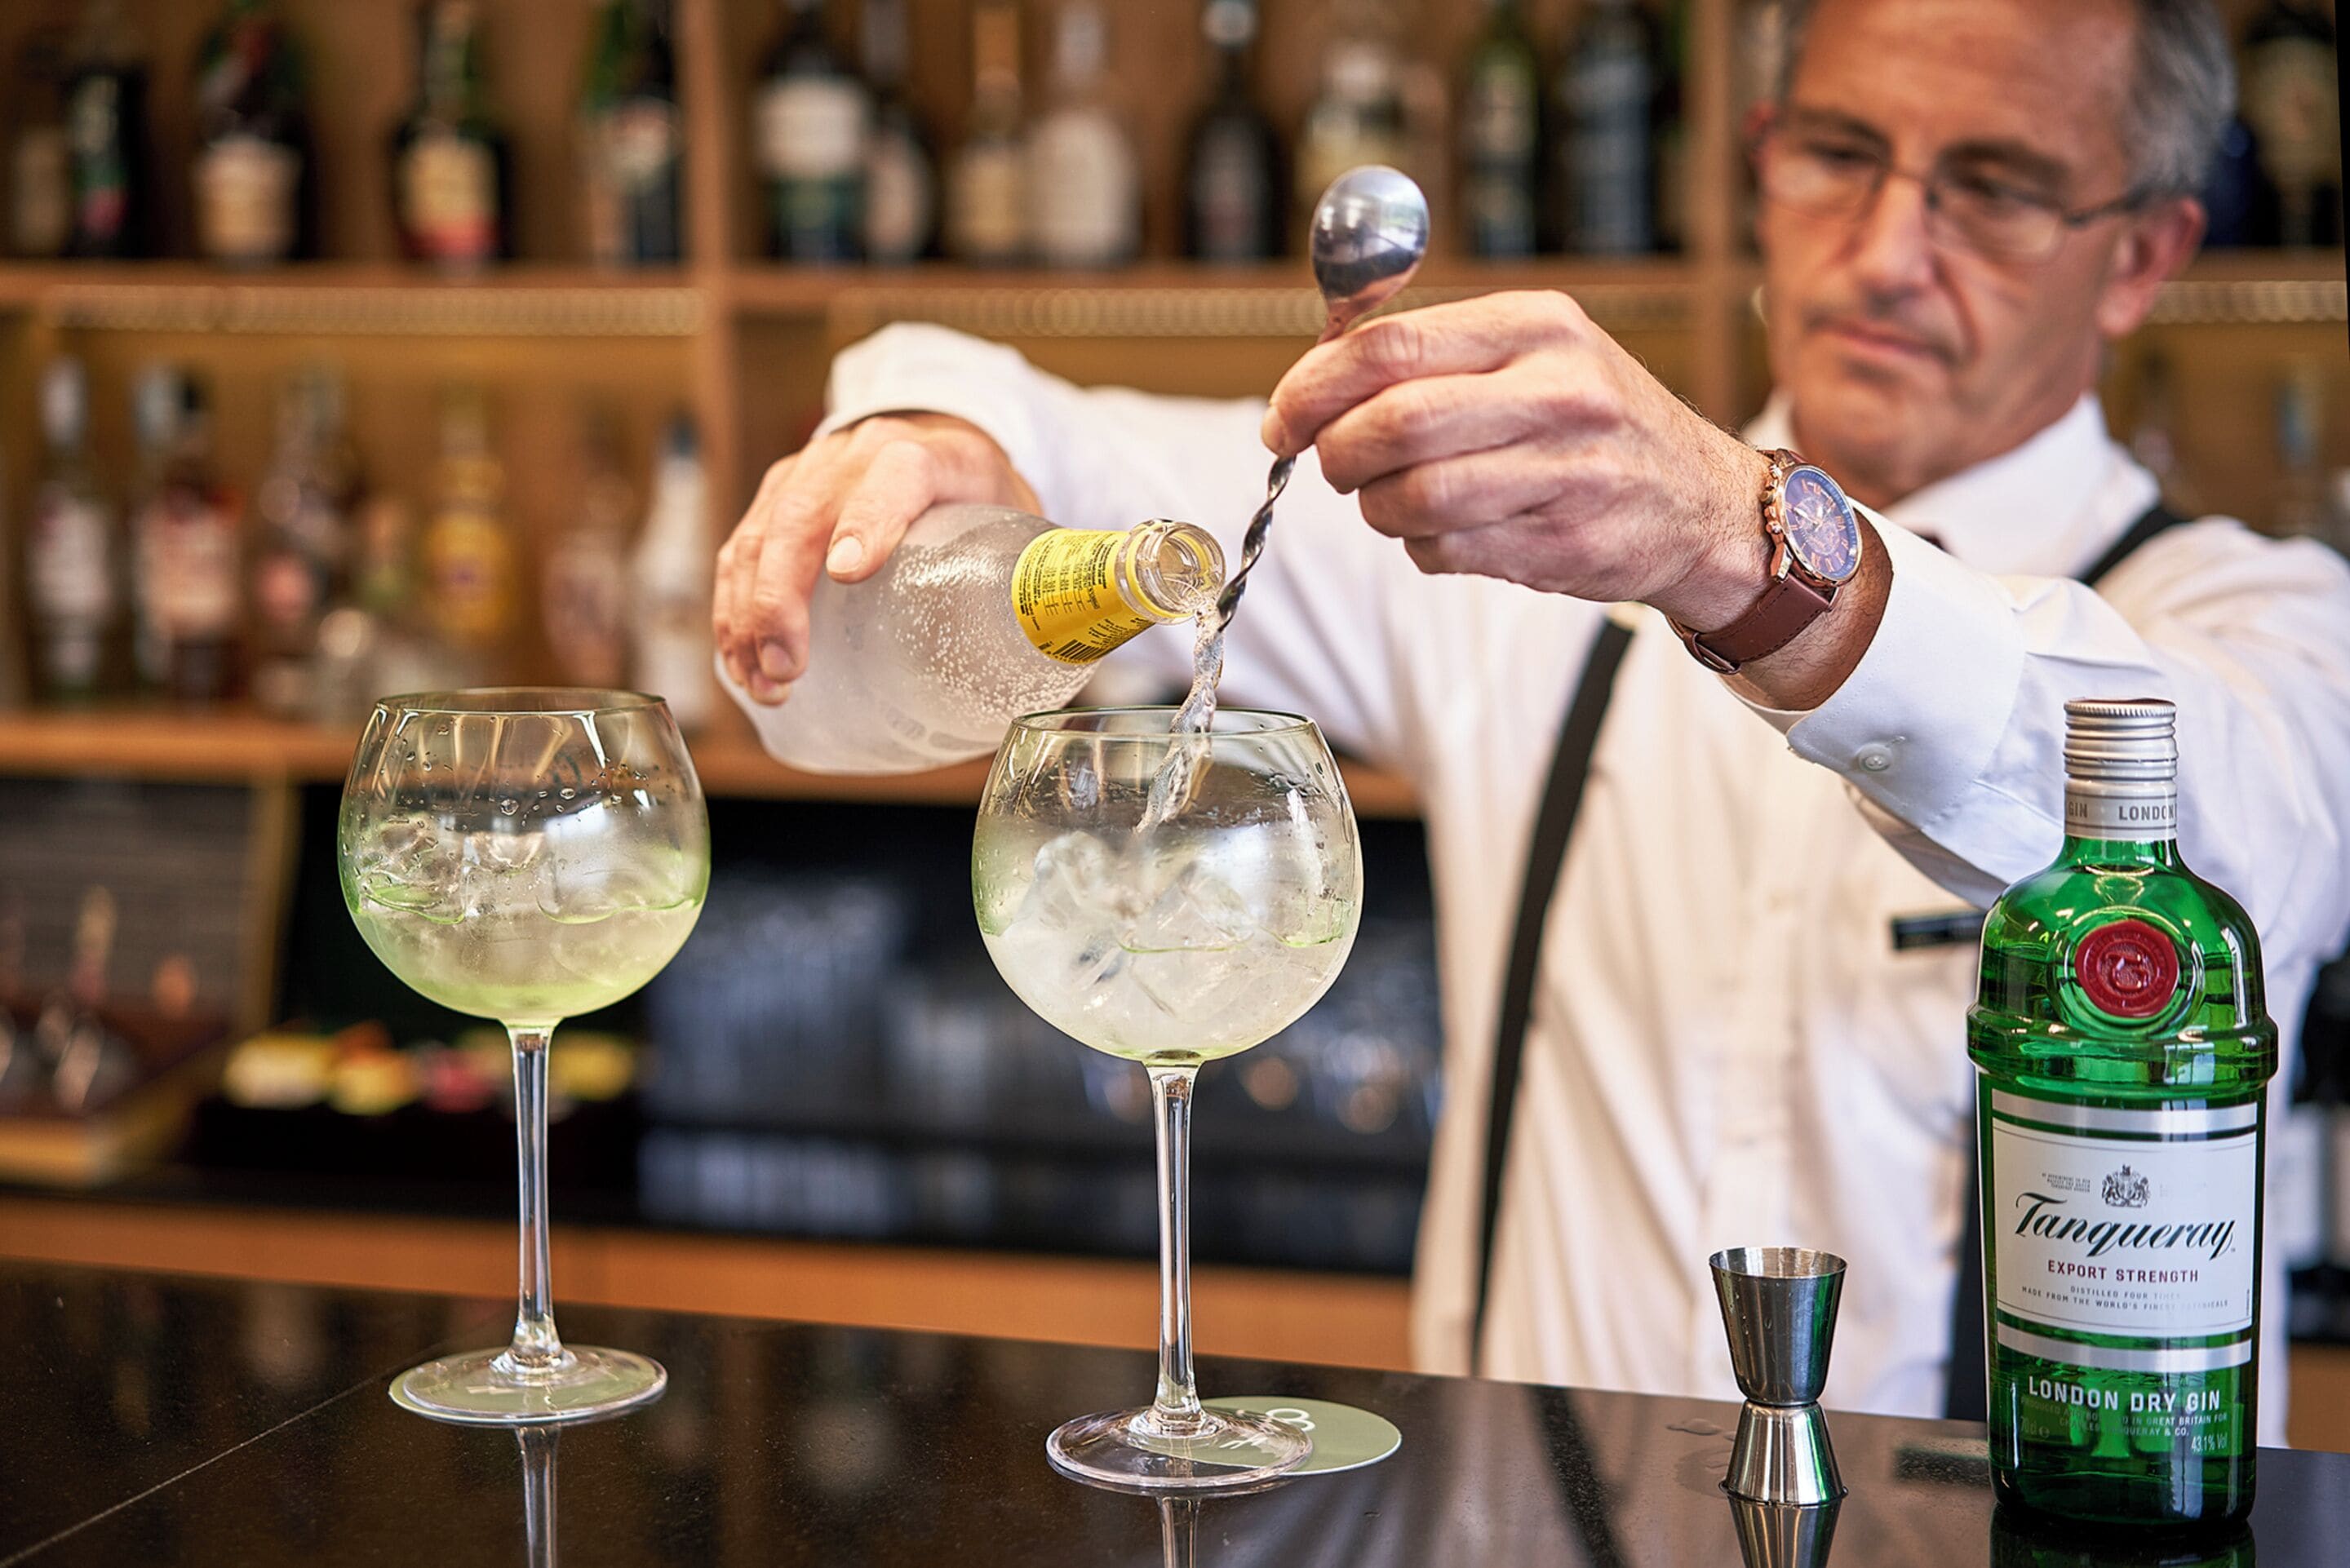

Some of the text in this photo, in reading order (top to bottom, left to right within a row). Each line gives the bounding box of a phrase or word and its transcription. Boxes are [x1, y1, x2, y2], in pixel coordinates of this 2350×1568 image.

[2068, 802, 2088, 818] GIN
[2015, 1192, 2237, 1261] Tanqueray
[2048, 1260, 2199, 1284] EXPORT STRENGTH
[2021, 1285, 2042, 1297] MADE
[2046, 1291, 2068, 1303] FROM
[2073, 1296, 2090, 1305] THE
[2095, 1299, 2138, 1310] WORLD'S
[2070, 1285, 2119, 1299] DISTILLED
[2123, 1291, 2148, 1300] FOUR
[2029, 1375, 2220, 1413] LONDON DRY GIN
[2179, 1415, 2212, 1426] BRITAIN
